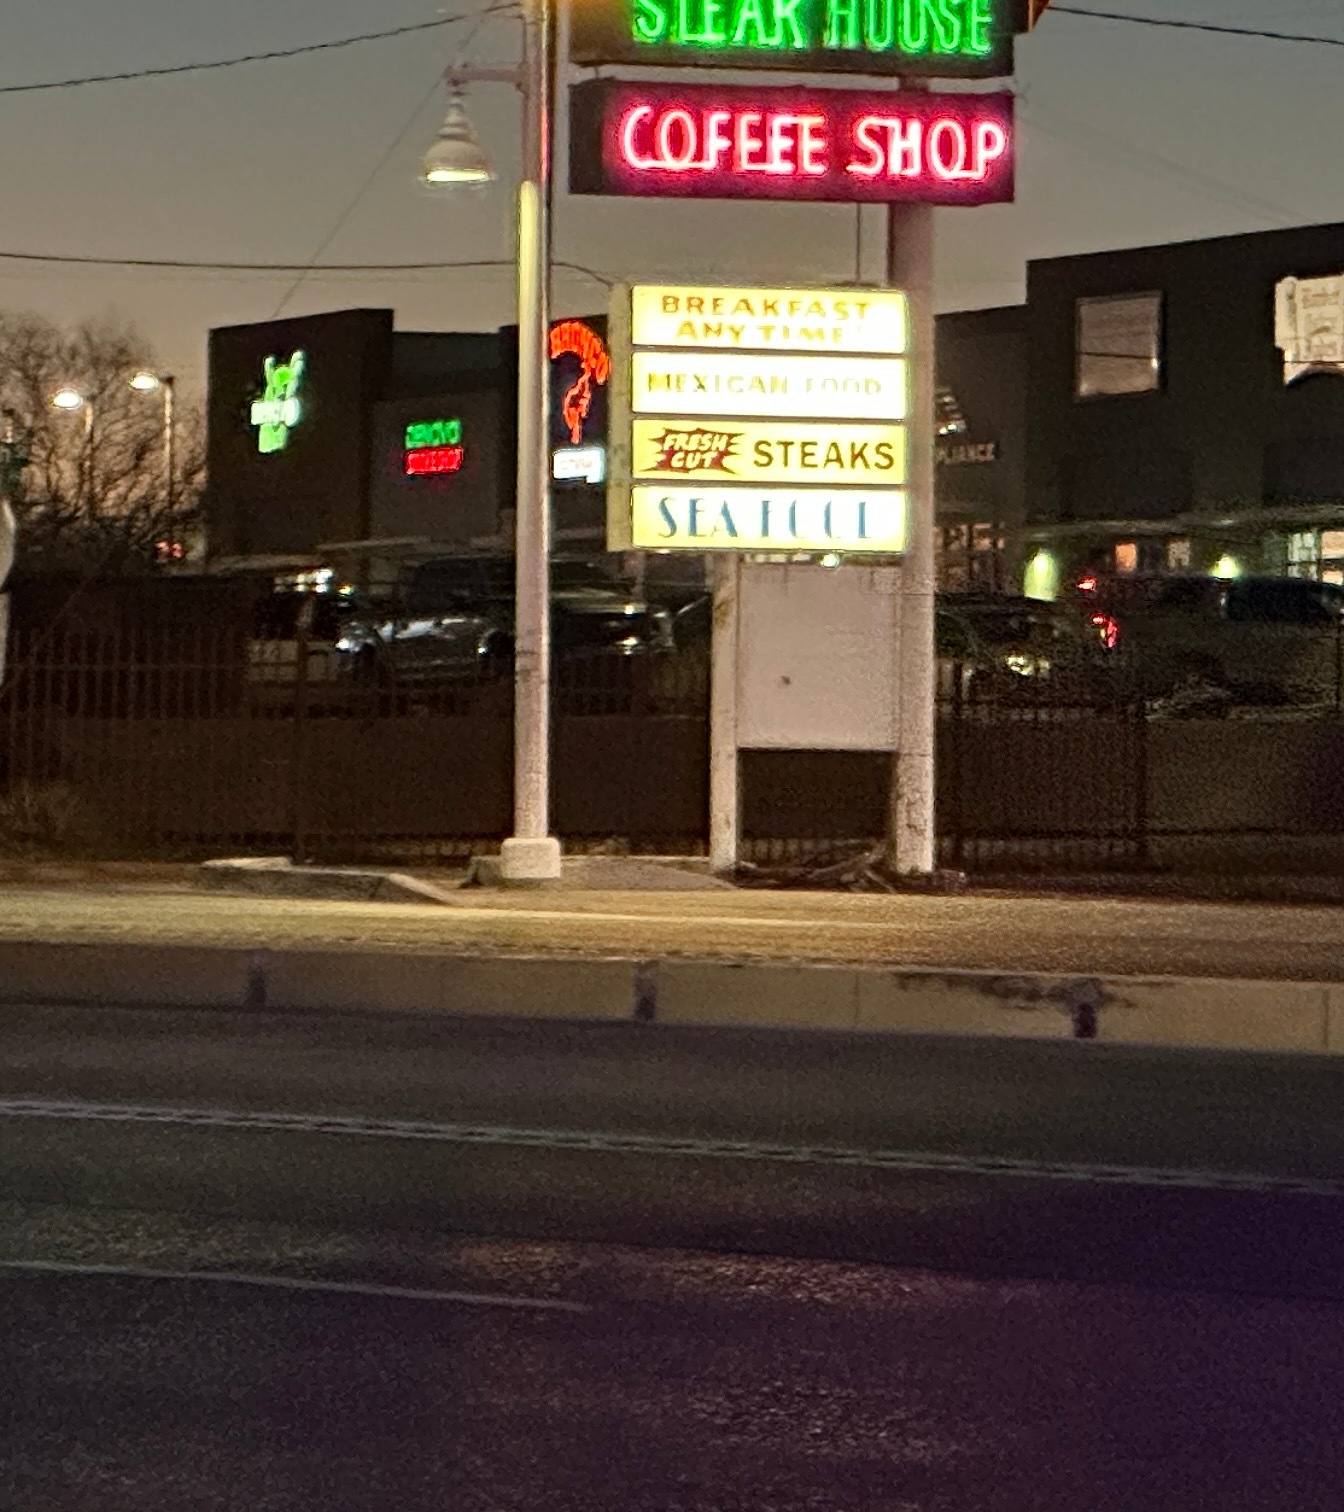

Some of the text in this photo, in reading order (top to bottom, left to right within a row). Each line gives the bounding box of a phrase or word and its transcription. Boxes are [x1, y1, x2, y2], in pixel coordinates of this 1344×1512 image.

[623, 105, 1006, 180] COFFEE SHOP
[661, 295, 871, 320] BREAKFAST
[676, 321, 746, 343] ANY
[648, 373, 788, 393] MEXICAN
[664, 432, 896, 470] FRESH STEAKS
[672, 452, 717, 468] CUT
